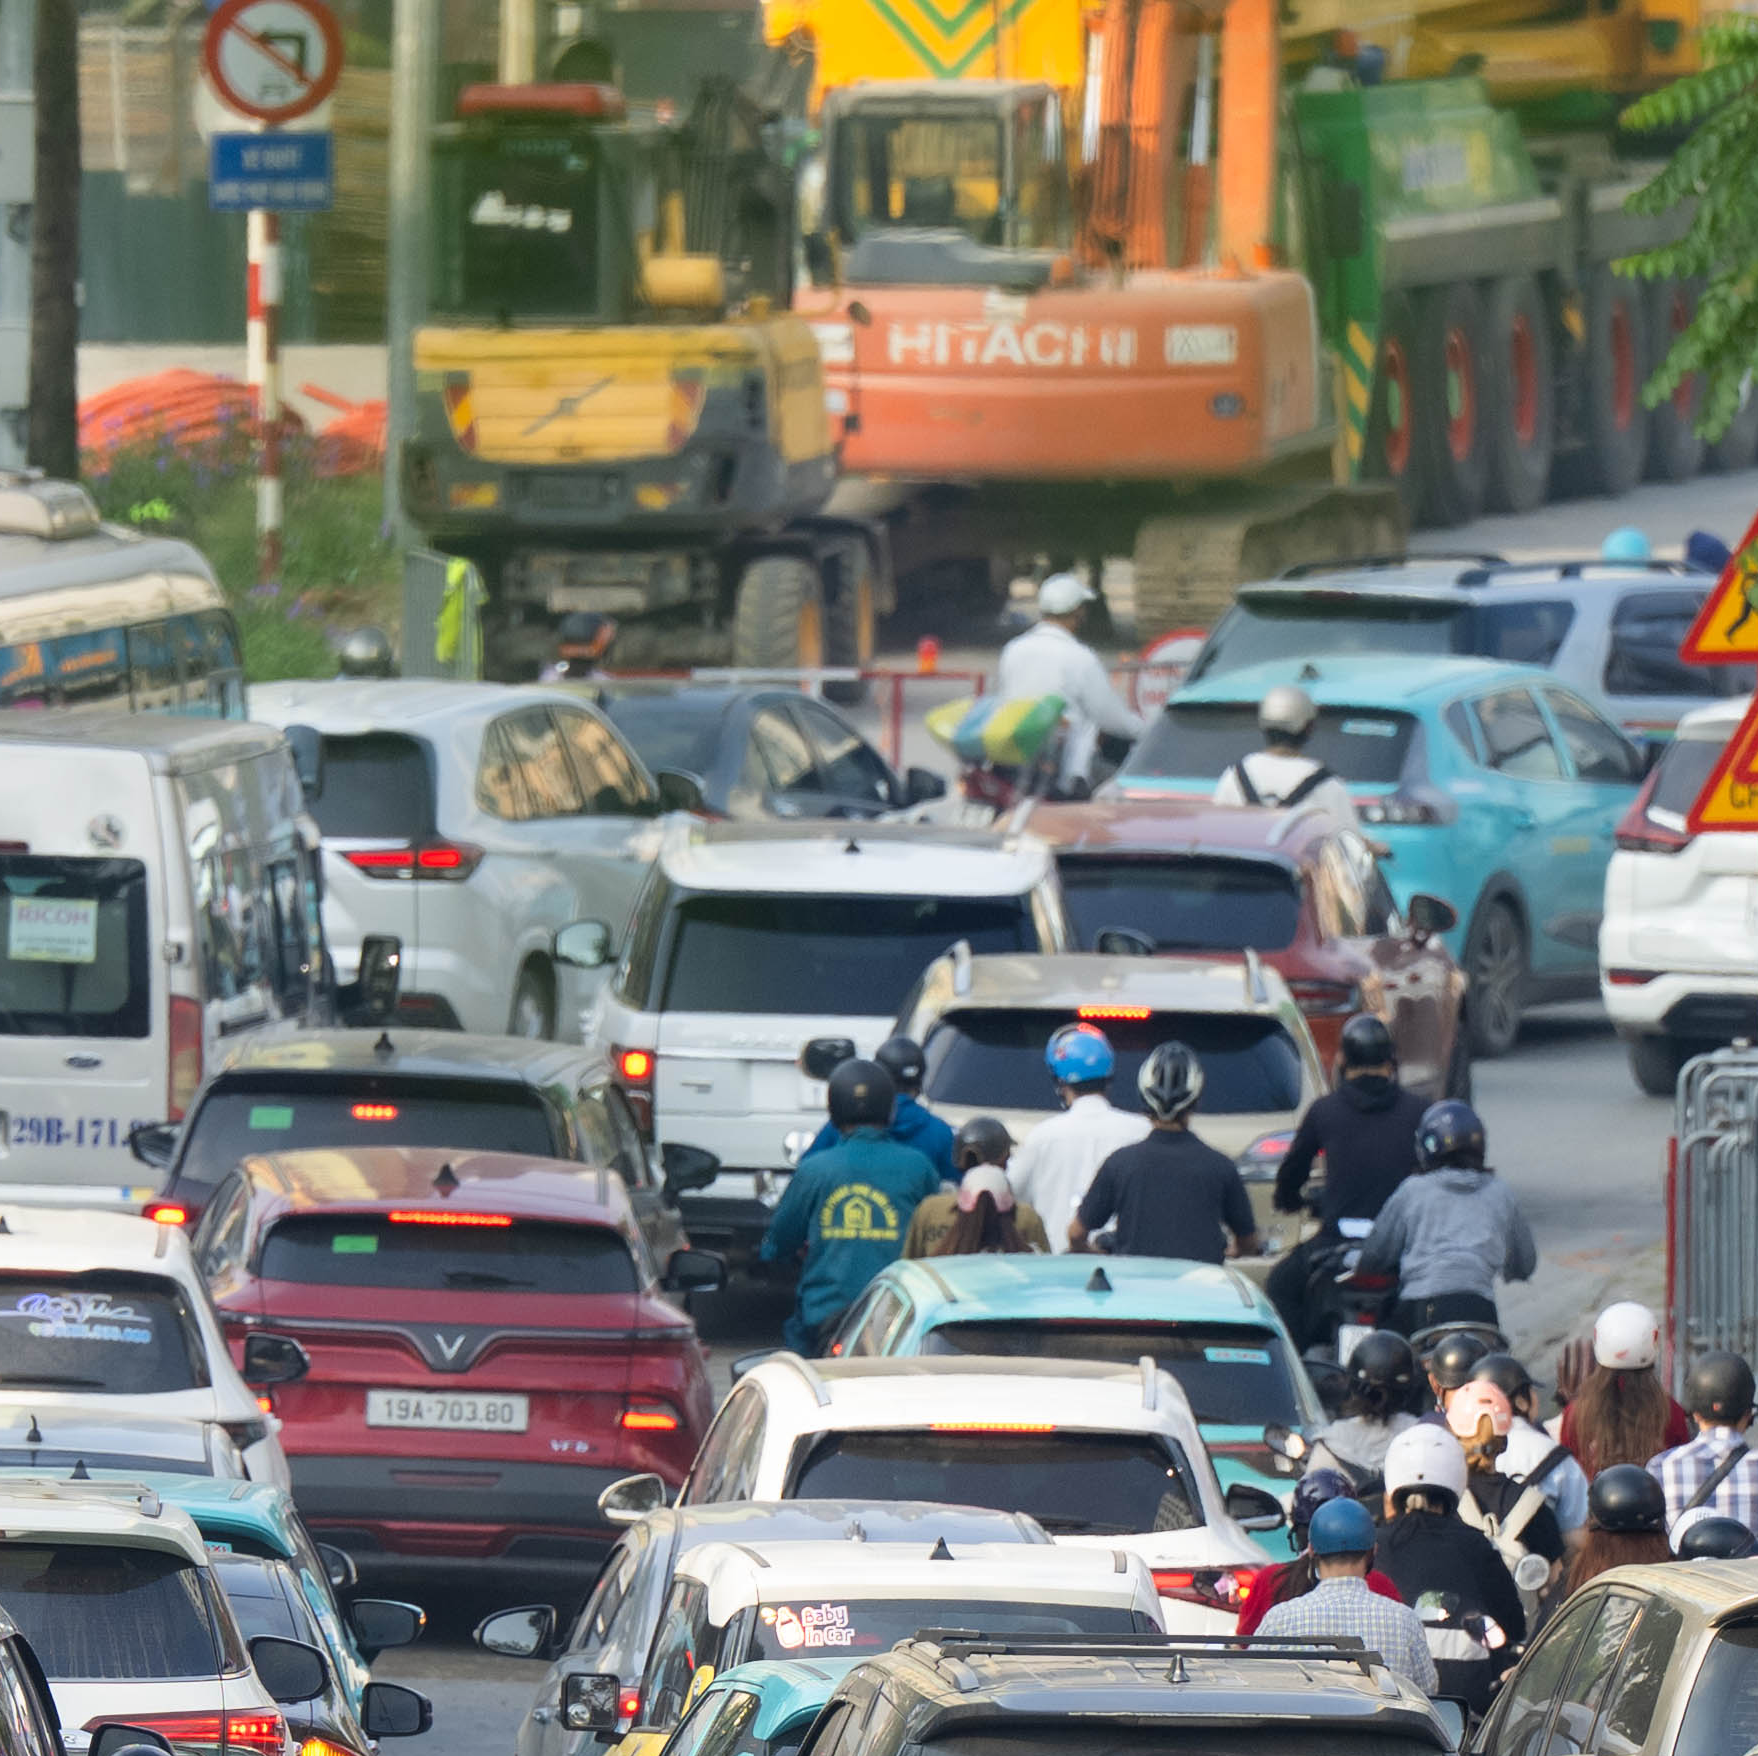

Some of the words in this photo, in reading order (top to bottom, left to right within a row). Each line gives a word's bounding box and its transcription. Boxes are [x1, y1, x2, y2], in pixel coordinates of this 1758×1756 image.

[886, 322, 1138, 368] HITACHI
[383, 1397, 514, 1425] 19A-703.80
[800, 1603, 850, 1628] Baby
[804, 1626, 823, 1647] In
[823, 1627, 856, 1647] Car
